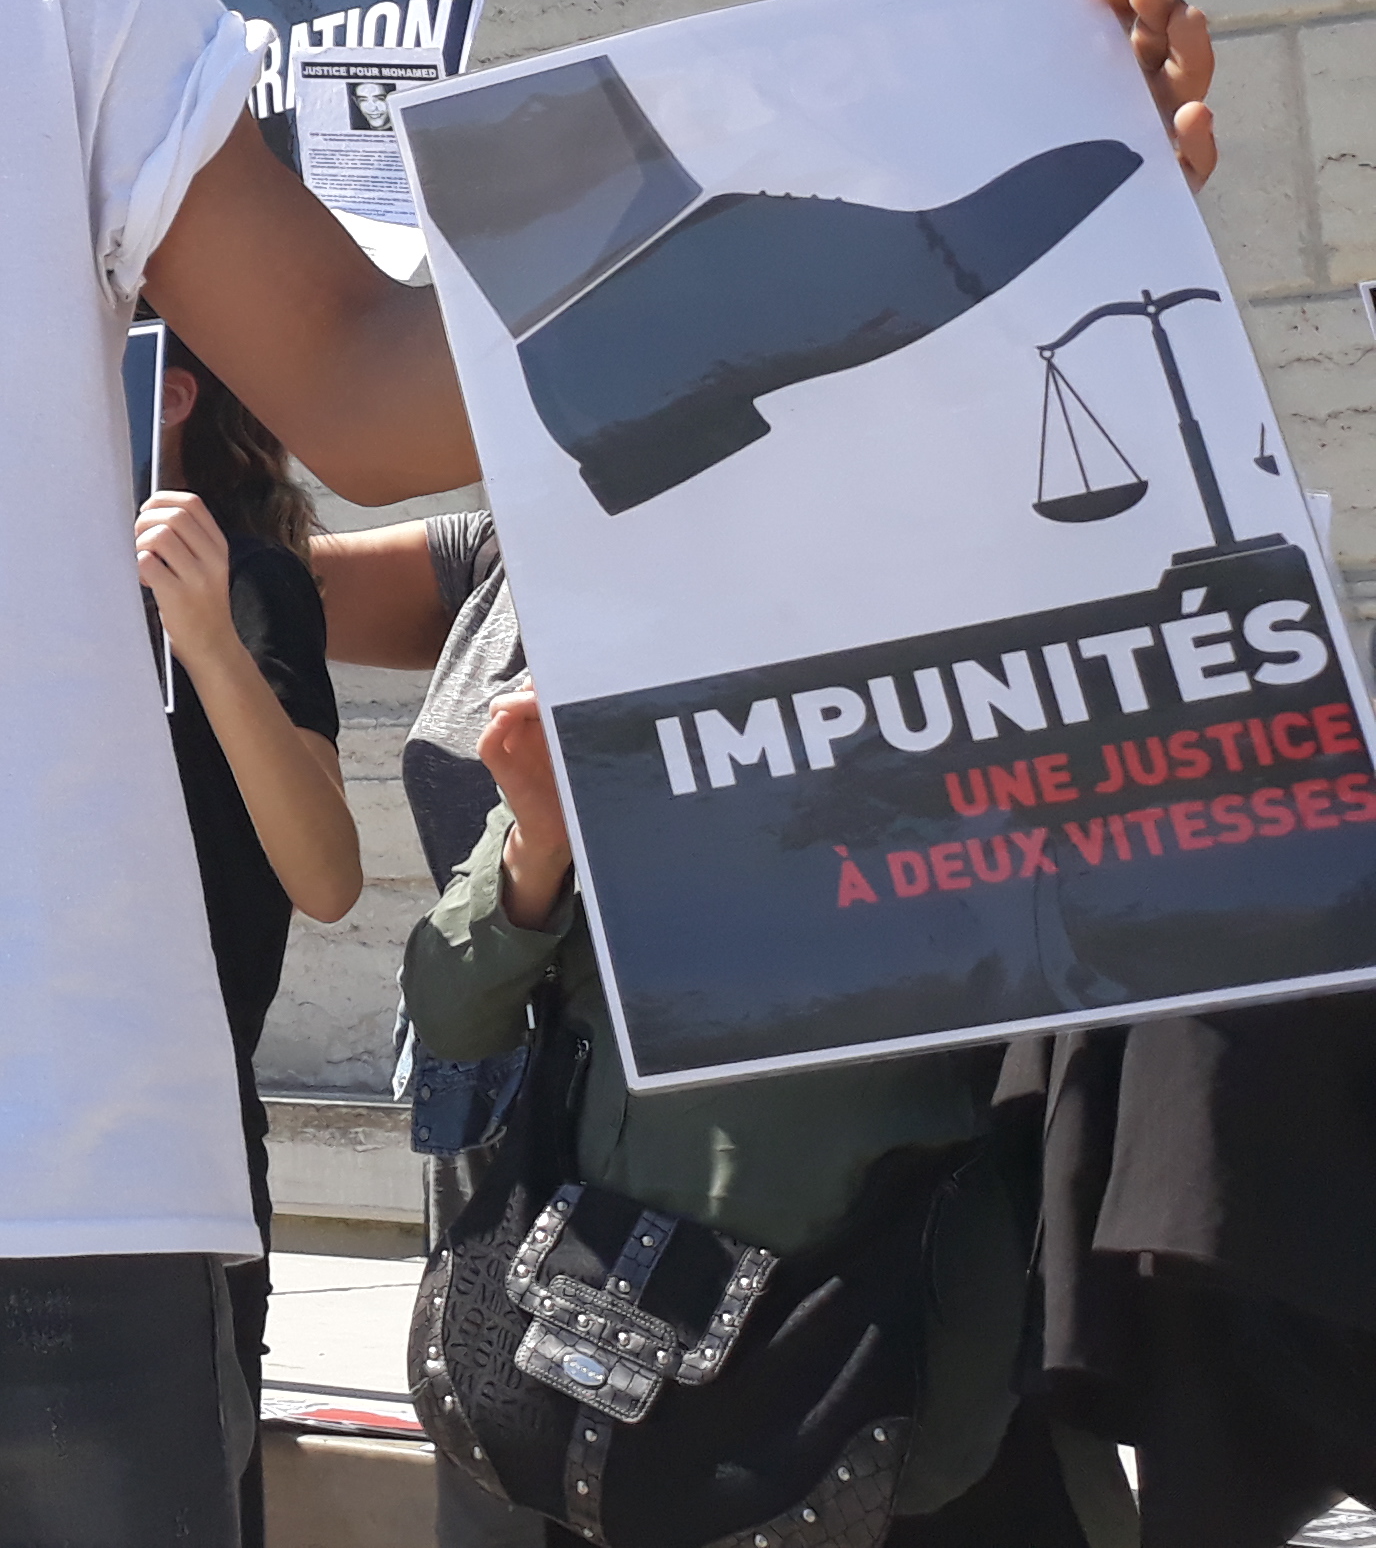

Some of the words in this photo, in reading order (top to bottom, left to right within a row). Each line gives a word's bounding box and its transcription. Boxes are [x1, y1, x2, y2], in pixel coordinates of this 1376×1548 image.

[303, 65, 348, 77] JUSTICE
[350, 67, 379, 77] POUR
[382, 67, 437, 78] MOHAMED
[654, 588, 1329, 796] IMPUNITÉS
[945, 753, 1080, 817] UNE
[1094, 702, 1363, 795] JUSTICE
[832, 844, 879, 909] À
[886, 827, 1060, 899] DEUX
[1063, 772, 1376, 867] VITESSES
